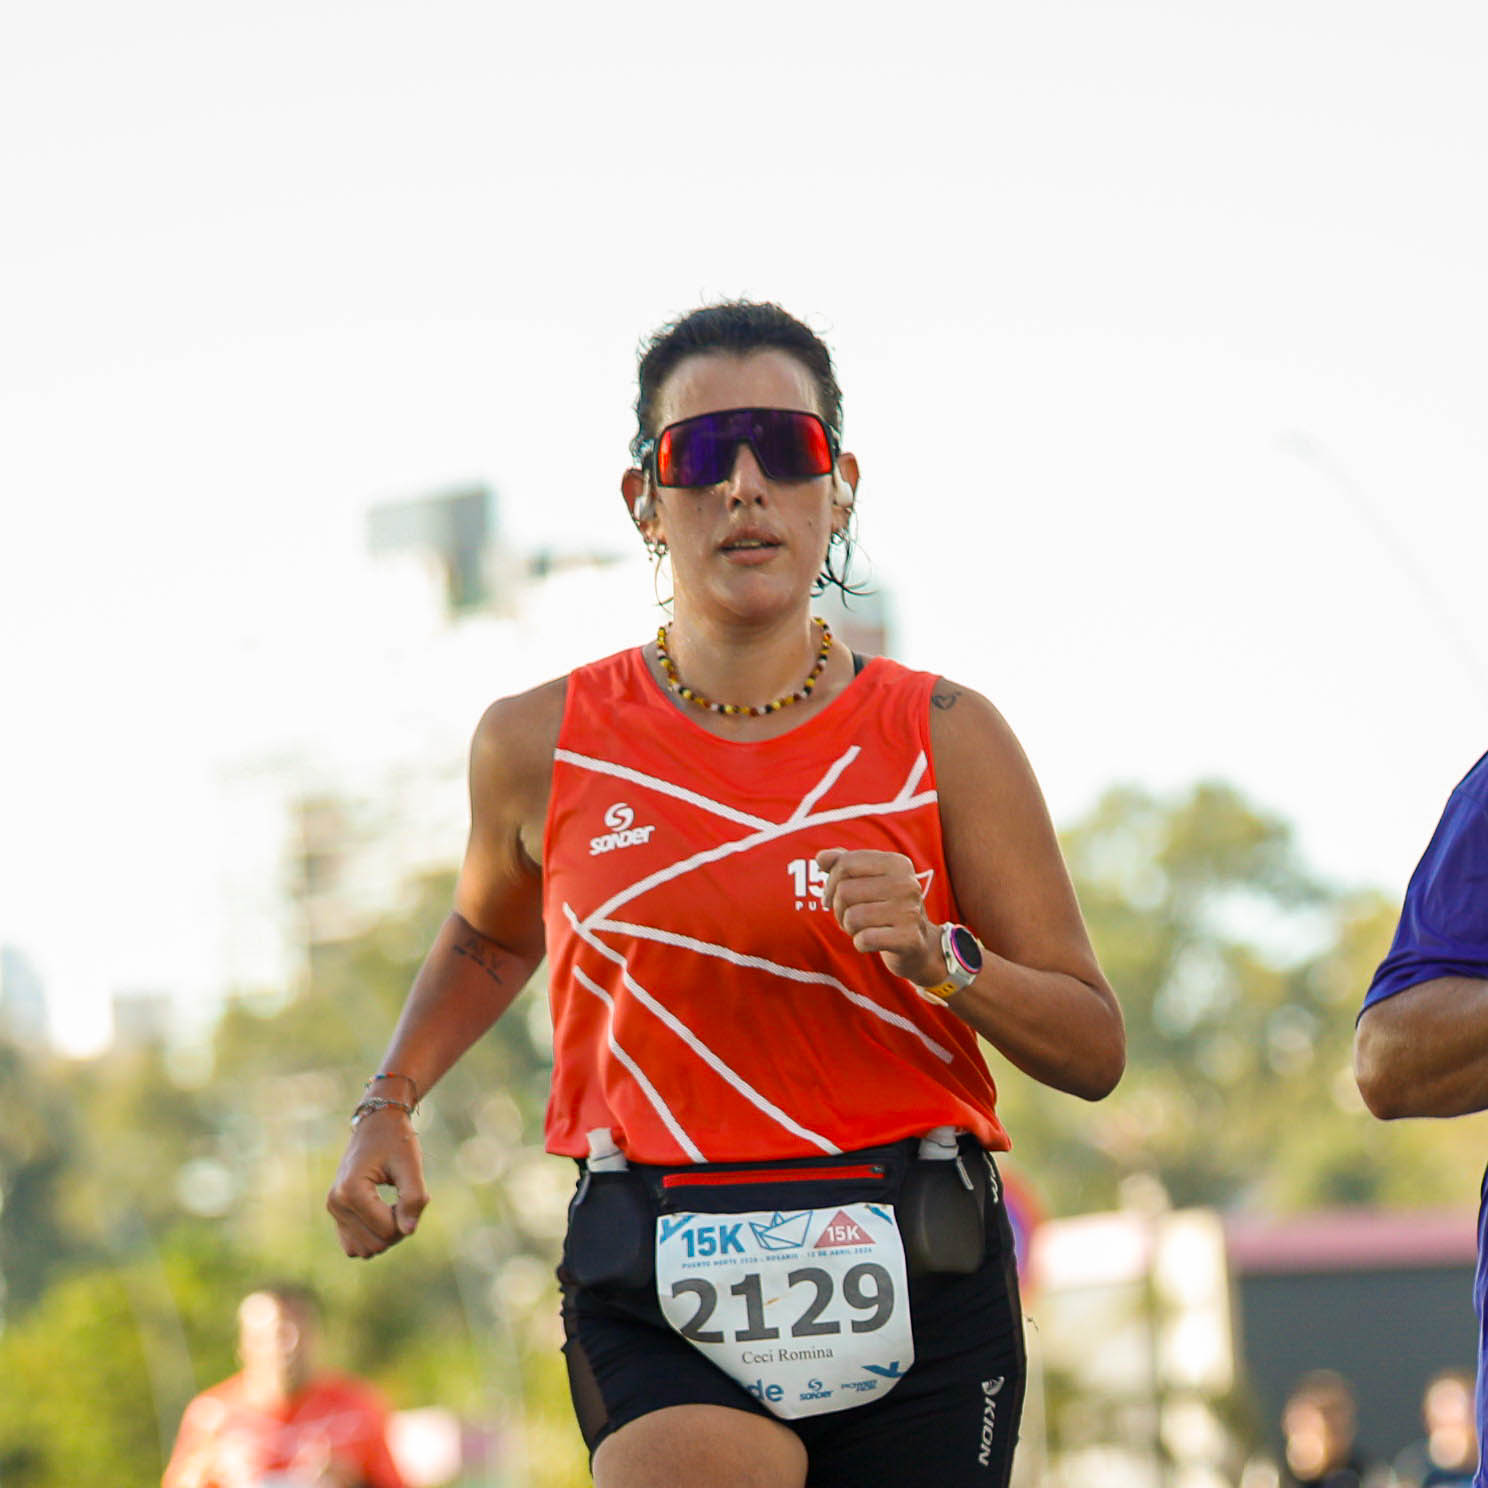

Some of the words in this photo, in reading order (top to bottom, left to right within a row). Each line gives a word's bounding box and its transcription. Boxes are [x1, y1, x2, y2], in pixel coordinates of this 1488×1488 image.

[681, 1223, 745, 1258] 15K
[827, 1224, 861, 1242] 15K
[672, 1262, 895, 1343] 2129
[742, 1349, 774, 1364] Ceci
[778, 1345, 834, 1361] Romina
